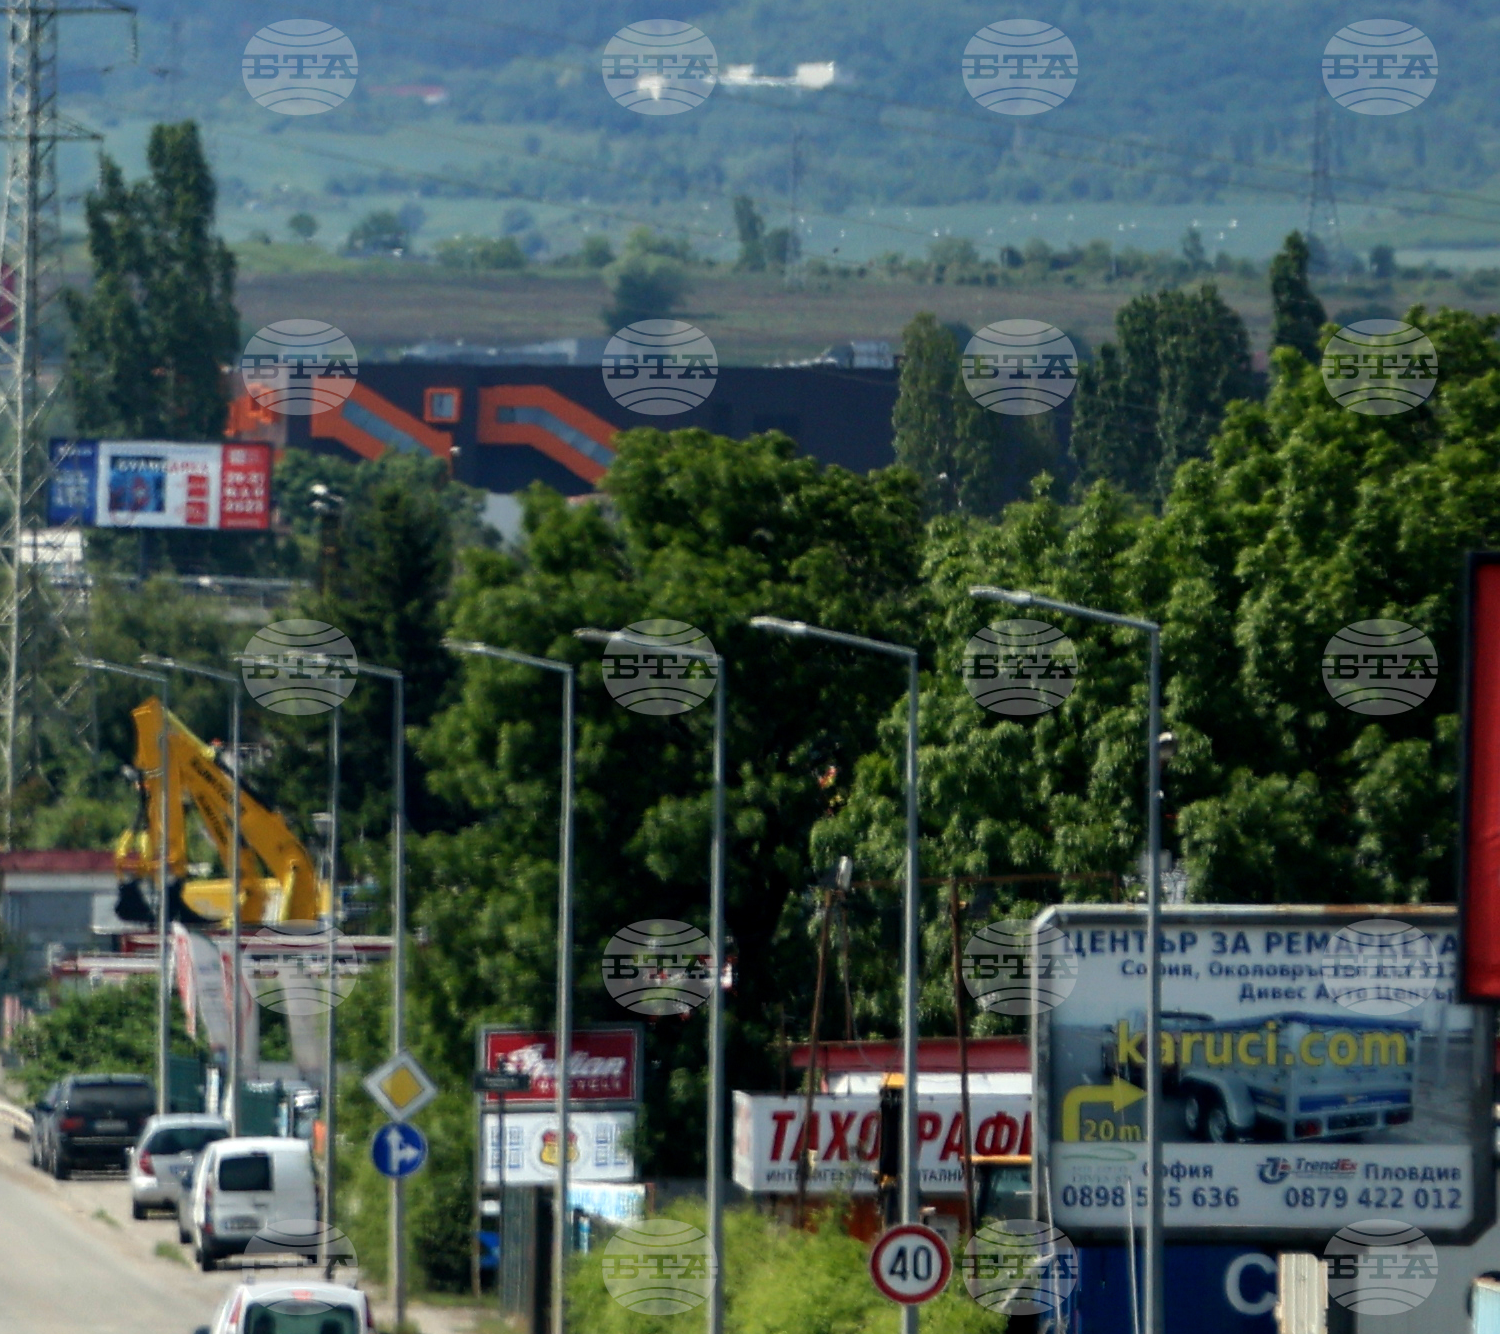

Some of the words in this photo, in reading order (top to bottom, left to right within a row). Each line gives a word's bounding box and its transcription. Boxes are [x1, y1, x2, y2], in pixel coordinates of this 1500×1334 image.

[1063, 930, 1198, 958] ЦЕНТЪР
[1211, 931, 1251, 955] ЗА
[1266, 931, 1457, 955] РЕМАРКЕТА
[1239, 983, 1307, 1004] Дивес
[1118, 1020, 1407, 1065] karuci.com
[770, 1110, 1032, 1162] ТАХОРАФ
[1083, 1119, 1115, 1142] 20
[1295, 1158, 1358, 1172] TrendEx
[1365, 1163, 1463, 1183] Пловдив
[1062, 1186, 1126, 1208] 0898
[1135, 1186, 1182, 1208] 55
[1192, 1186, 1240, 1208] 636
[1285, 1187, 1348, 1209] 0879
[1357, 1187, 1404, 1209] 422
[1414, 1187, 1463, 1209] 012
[889, 1245, 933, 1282] 40
